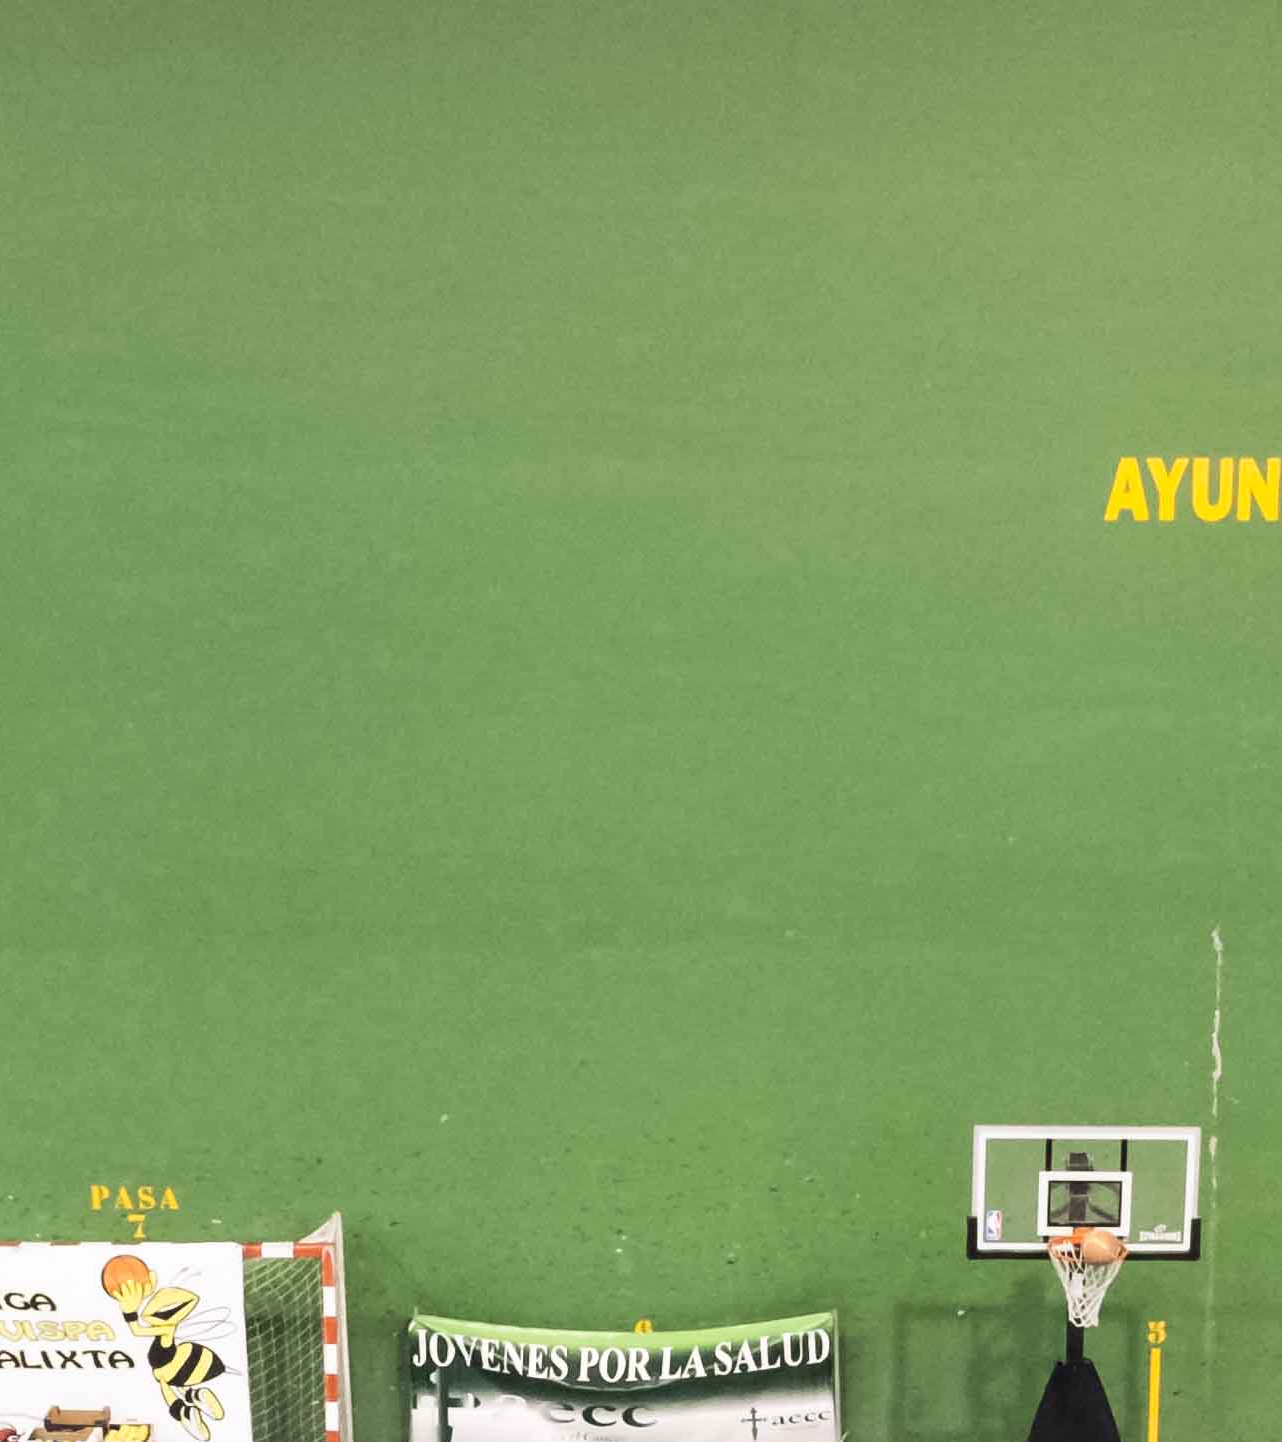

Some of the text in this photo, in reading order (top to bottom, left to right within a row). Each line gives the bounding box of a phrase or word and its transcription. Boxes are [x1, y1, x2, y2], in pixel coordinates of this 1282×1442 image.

[90, 1184, 179, 1210] PASA
[126, 1214, 145, 1239] 7
[412, 1328, 830, 1383] JOVENES POR LA SALUD
